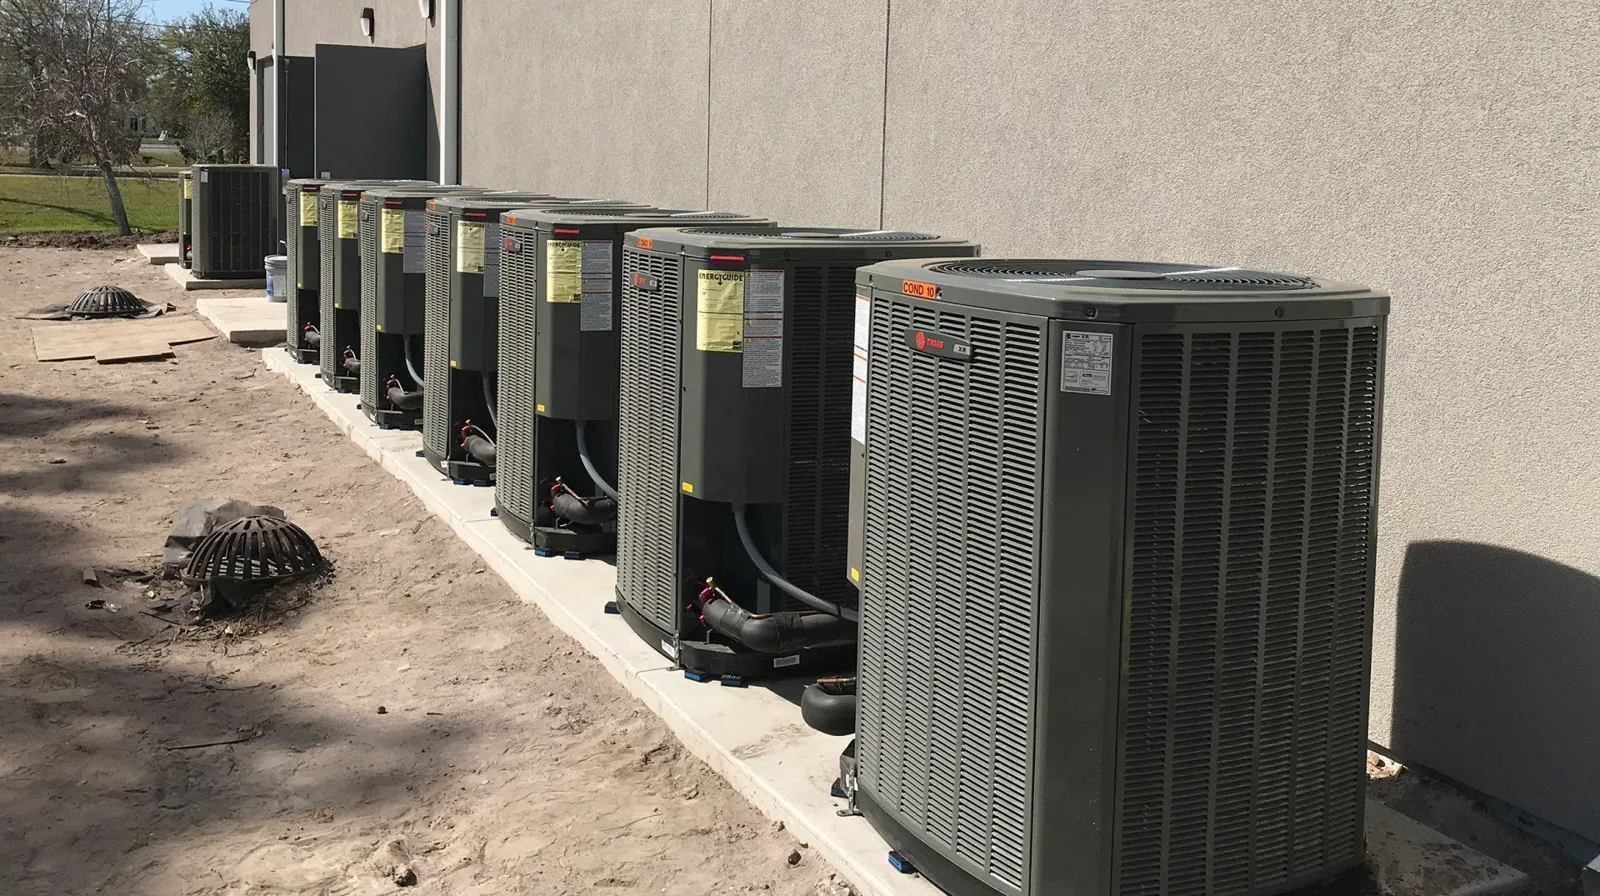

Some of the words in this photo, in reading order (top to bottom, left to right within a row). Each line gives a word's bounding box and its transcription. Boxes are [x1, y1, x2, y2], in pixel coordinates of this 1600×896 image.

[699, 272, 744, 282] ENERGYGUIDE
[903, 282, 924, 295] COND
[926, 287, 935, 298] 10
